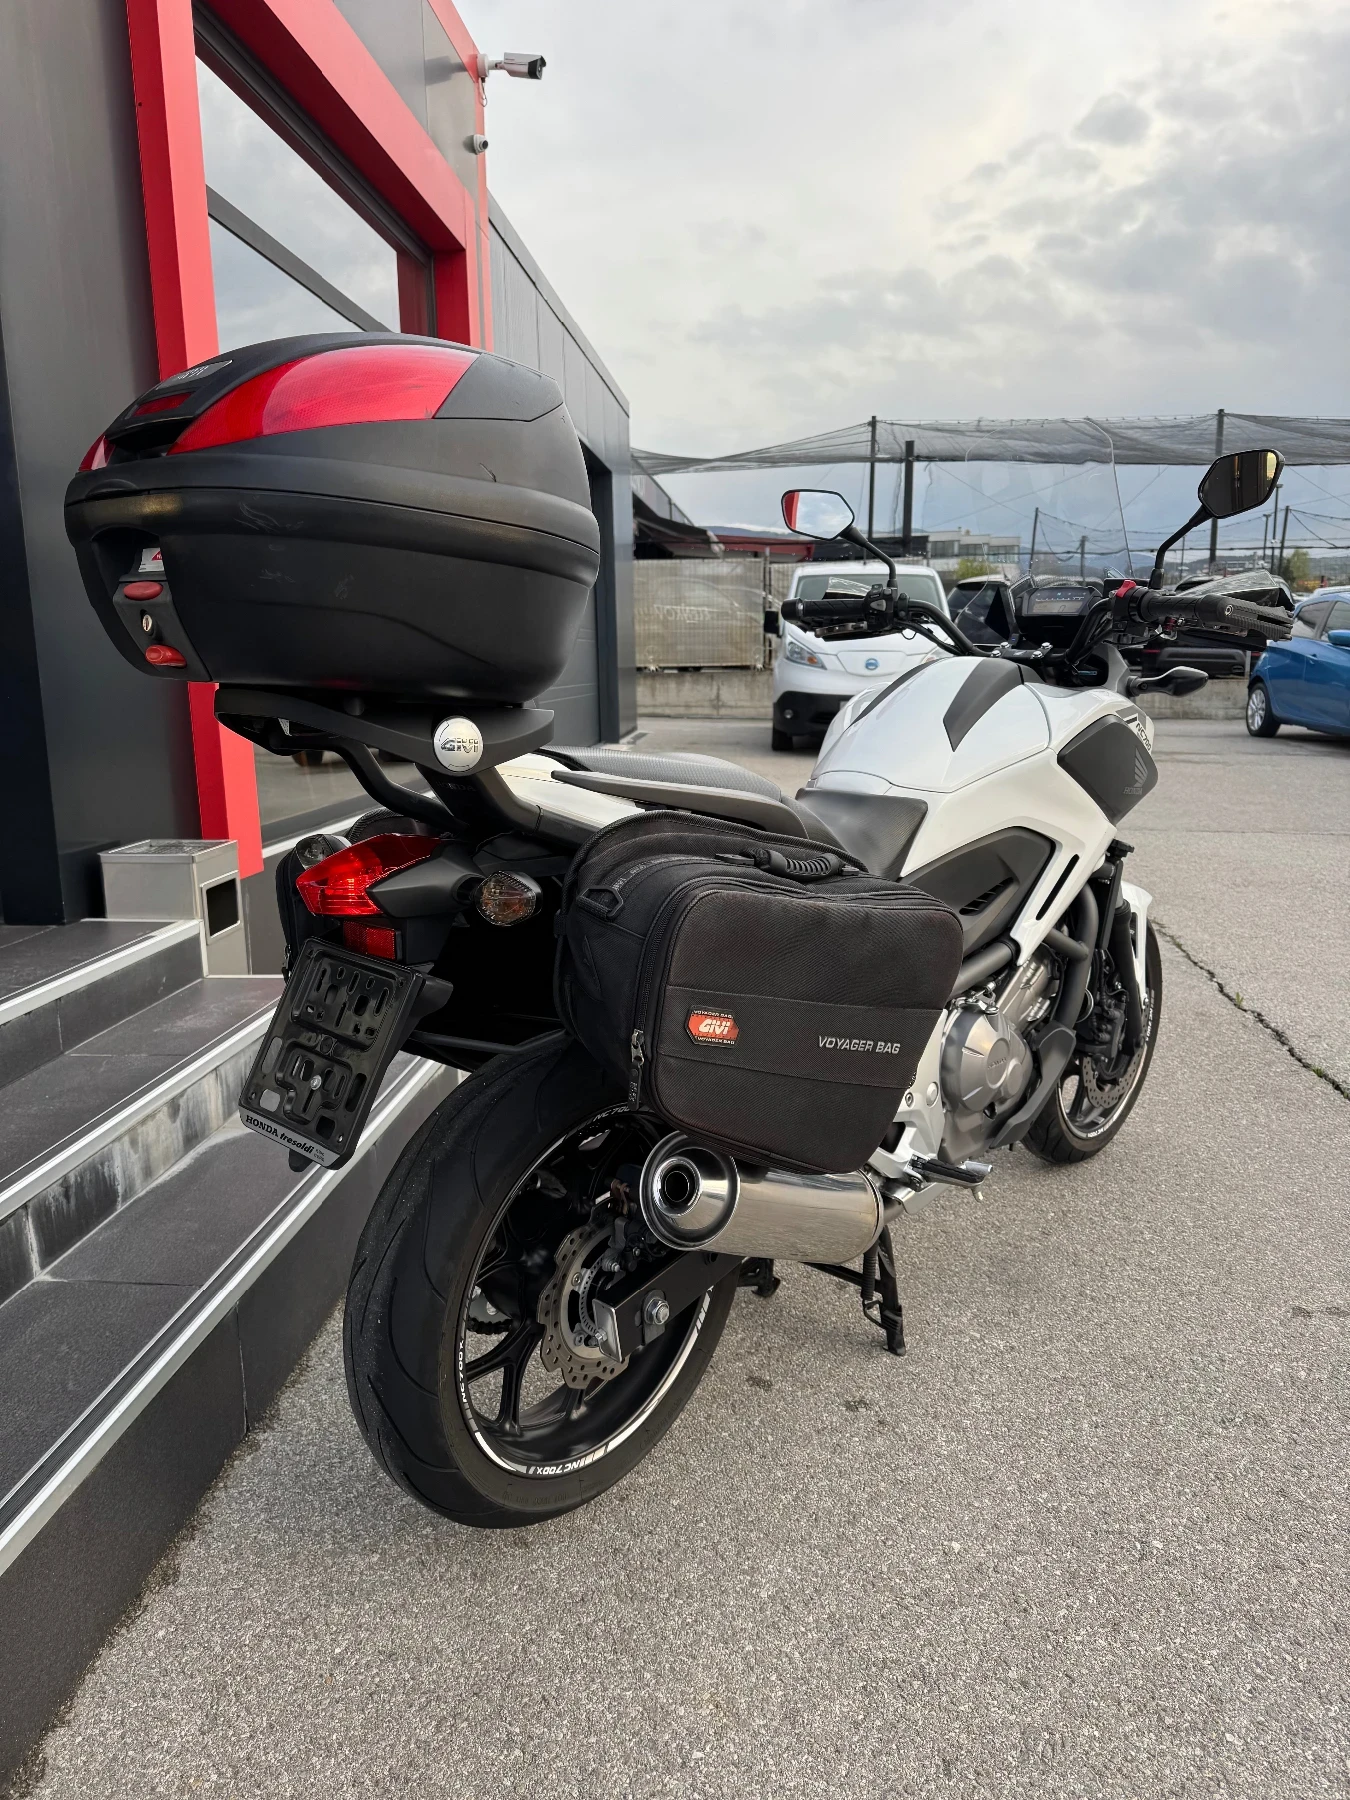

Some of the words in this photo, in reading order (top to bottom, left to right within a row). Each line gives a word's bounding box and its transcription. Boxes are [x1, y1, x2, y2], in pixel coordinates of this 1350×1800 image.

[440, 738, 479, 754] GIVI
[699, 1019, 731, 1035] GIVI
[818, 1035, 874, 1052] VOYAGER
[875, 1041, 901, 1055] BAG
[245, 1114, 279, 1138] HONDA
[279, 1132, 315, 1155] tresoldi
[458, 1339, 468, 1403] NC700X
[536, 1459, 581, 1475] NC700X
